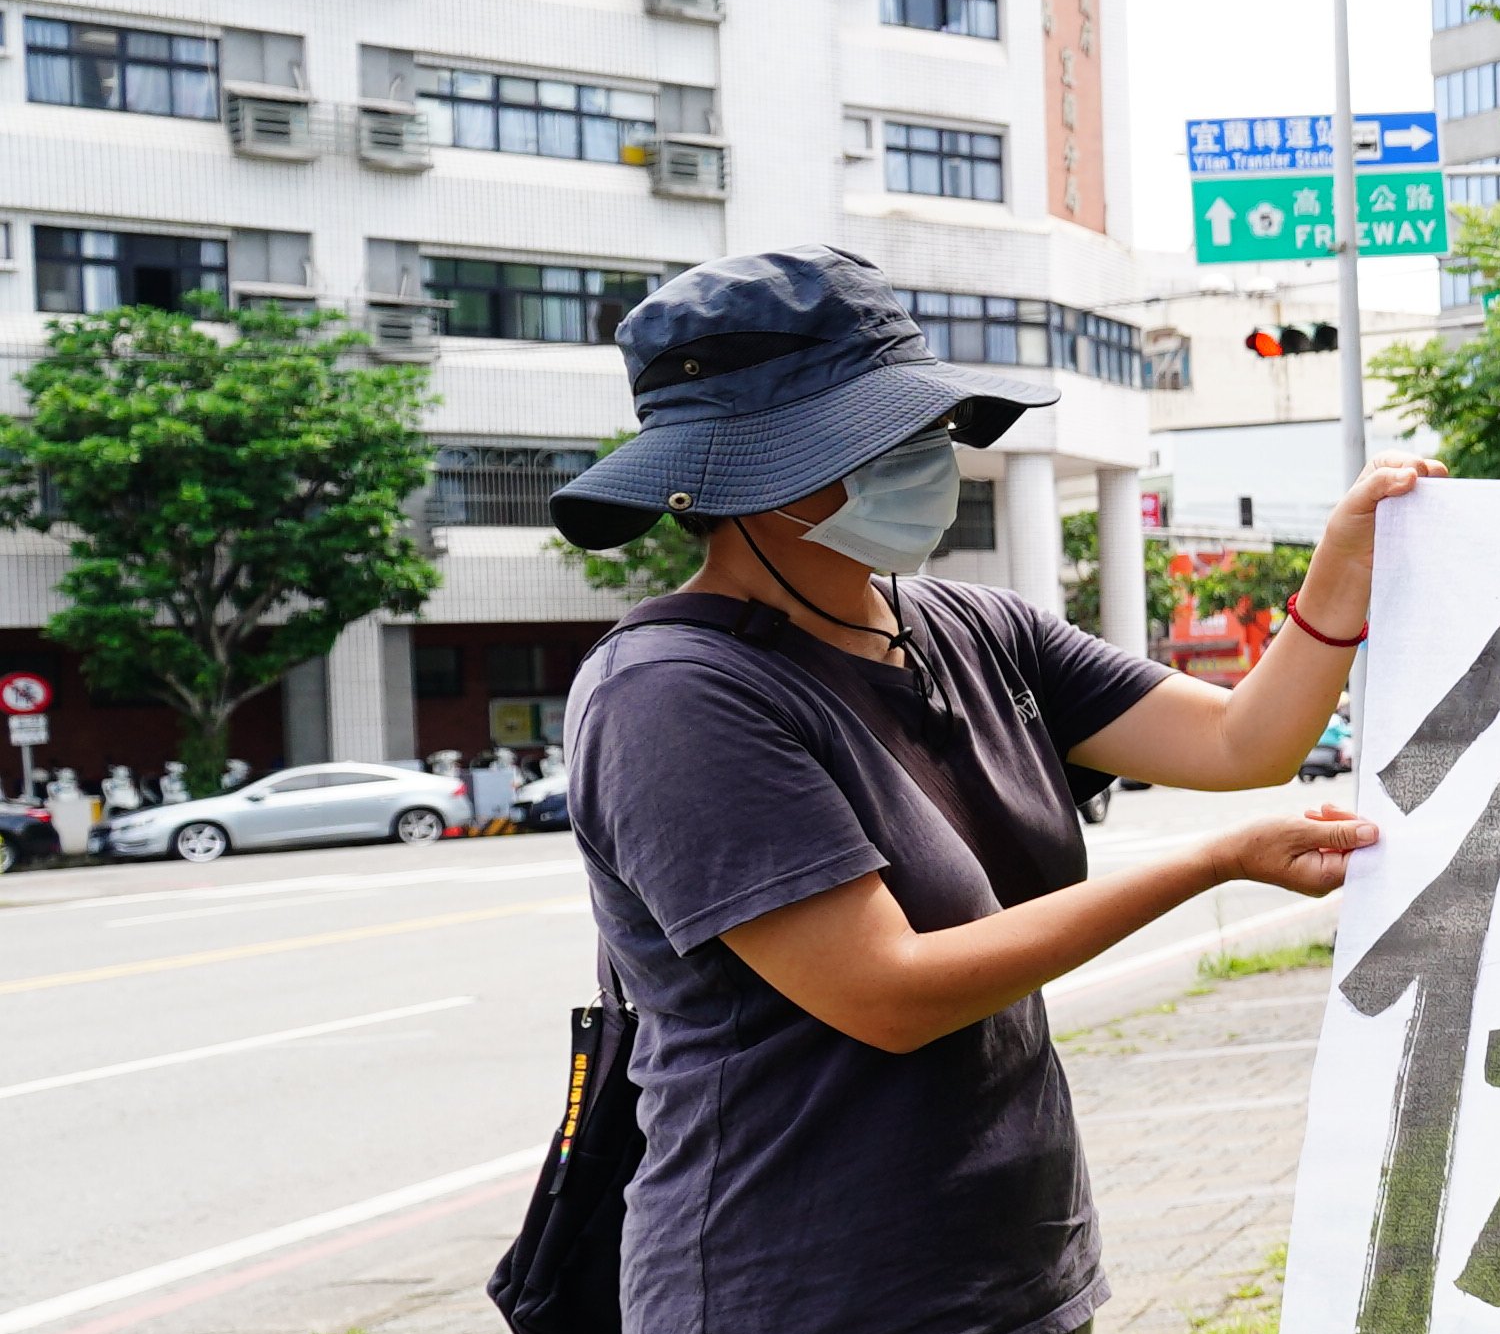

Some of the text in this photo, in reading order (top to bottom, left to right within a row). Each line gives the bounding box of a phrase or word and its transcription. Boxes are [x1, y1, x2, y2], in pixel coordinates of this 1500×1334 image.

[1193, 149, 1334, 171] Yilan Transfer Stati
[1292, 183, 1434, 218] 高公路
[1294, 219, 1437, 250] FREWAY
